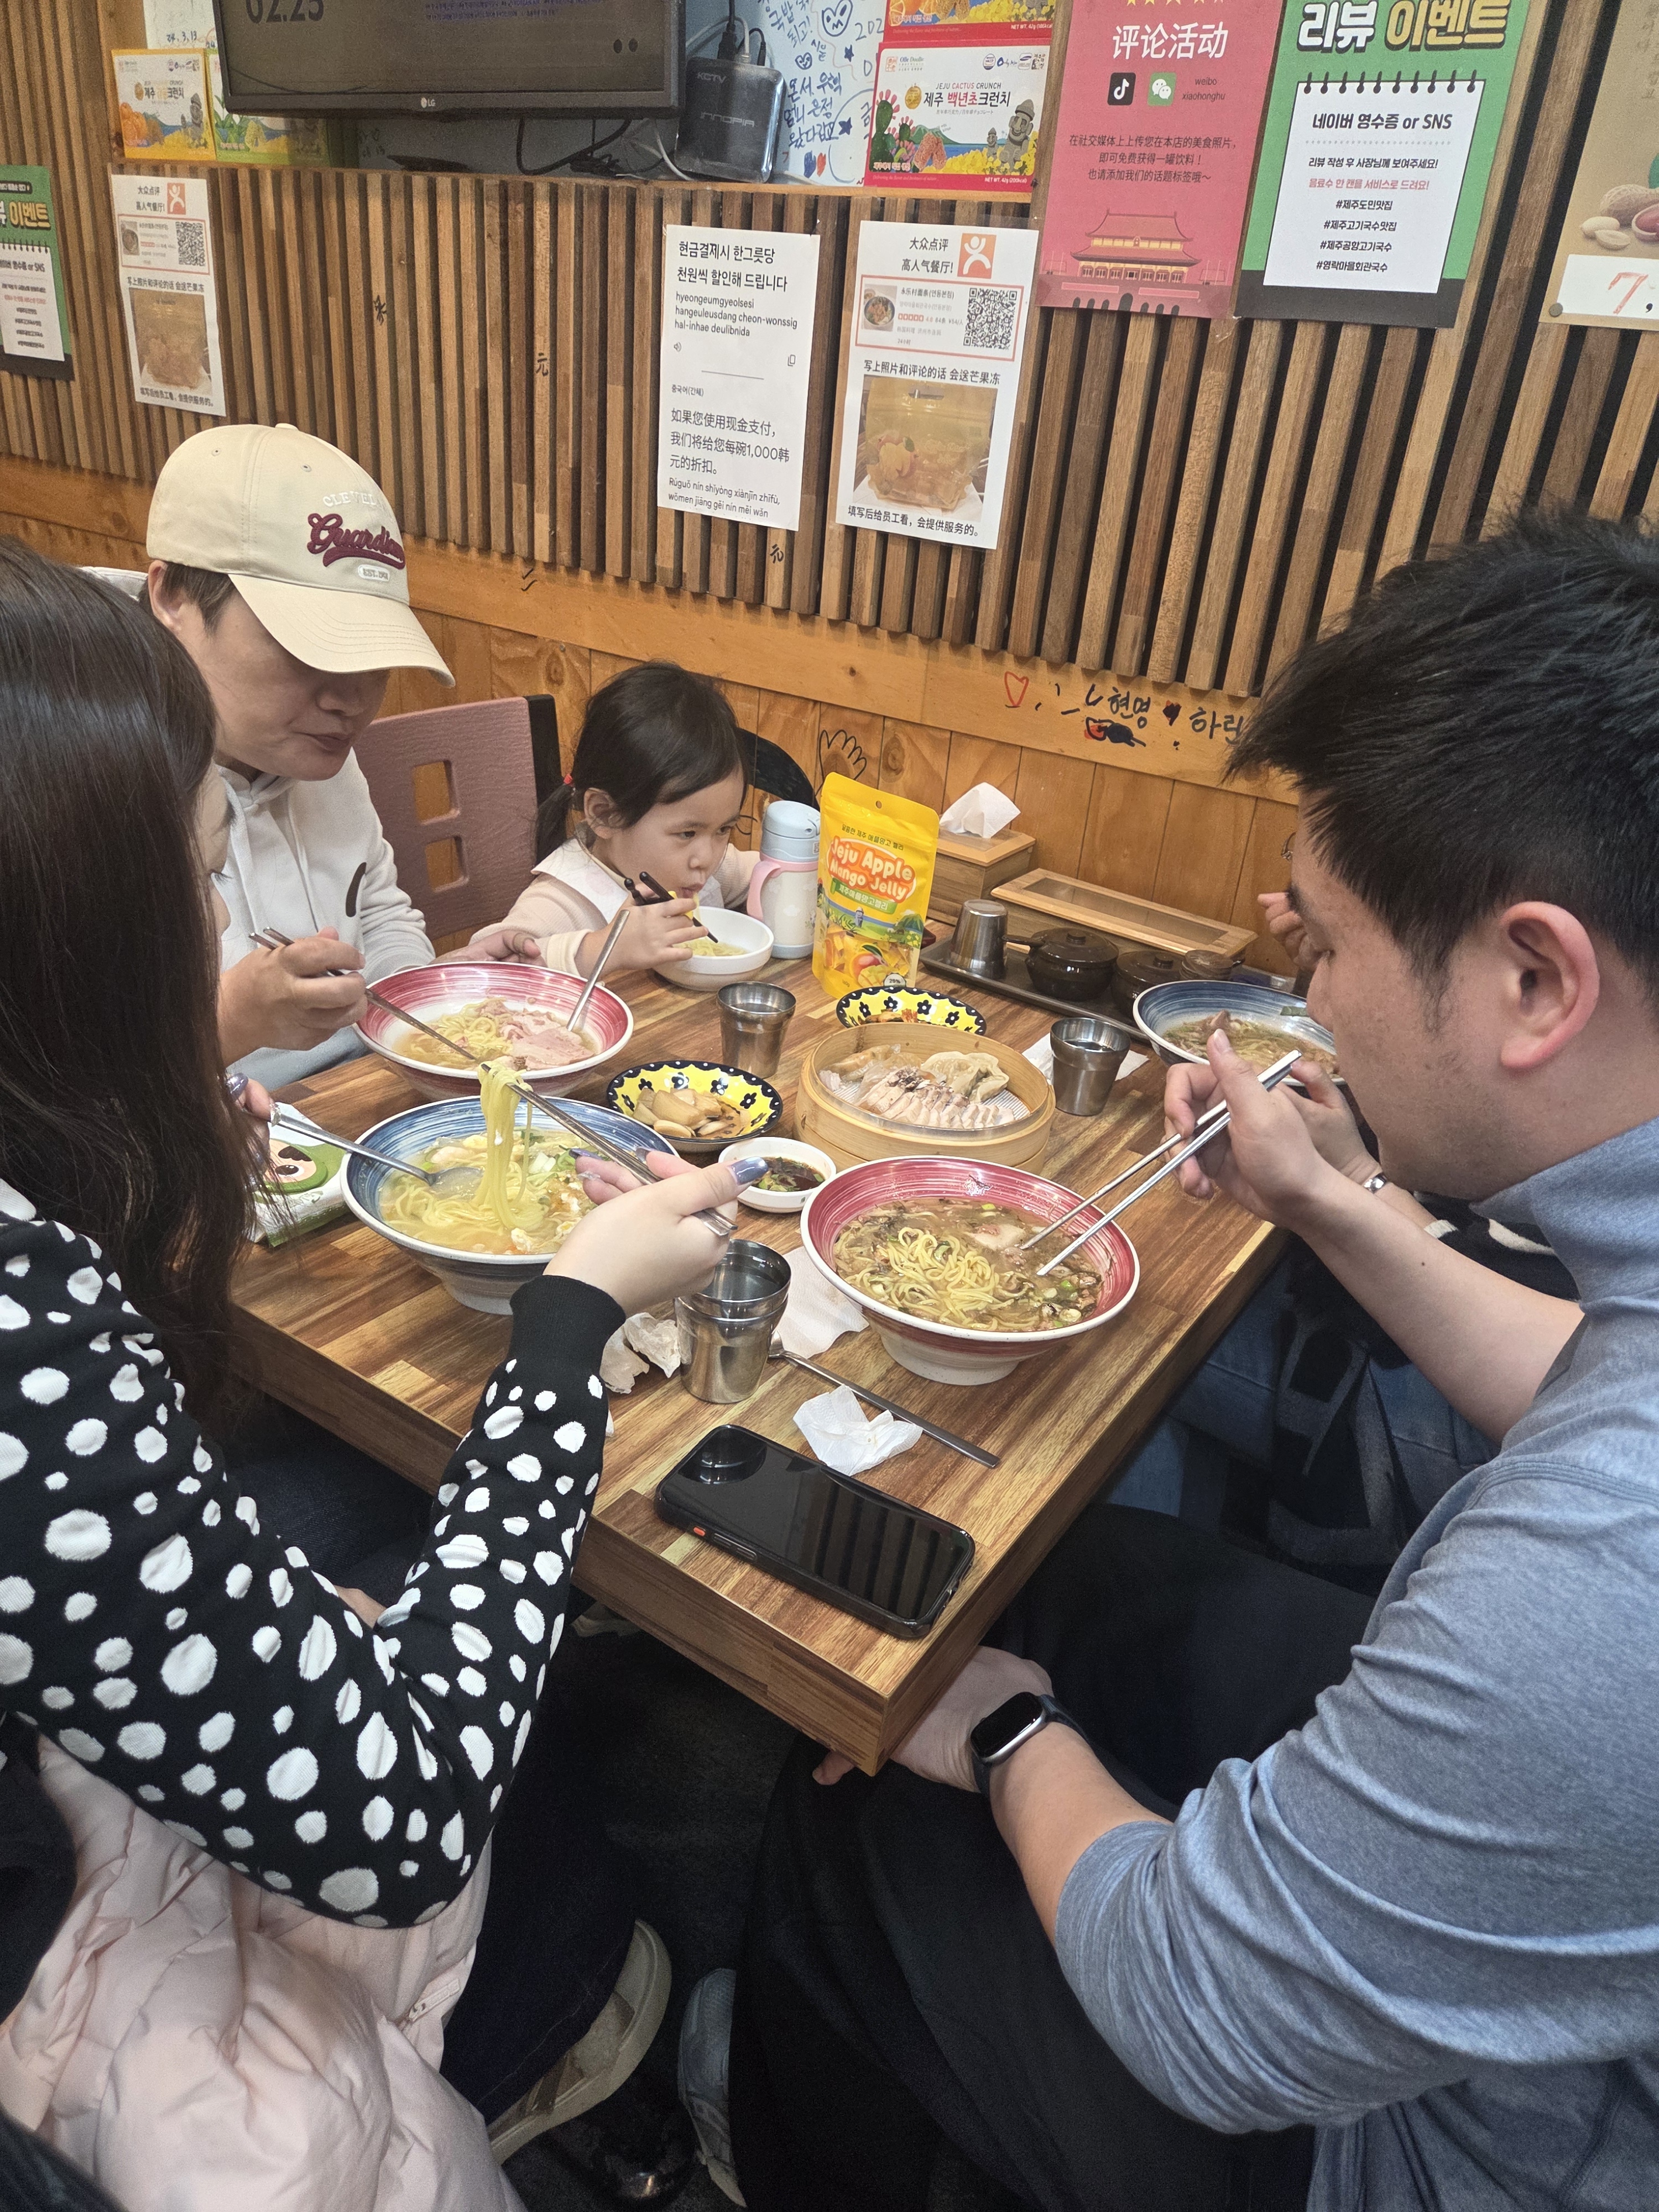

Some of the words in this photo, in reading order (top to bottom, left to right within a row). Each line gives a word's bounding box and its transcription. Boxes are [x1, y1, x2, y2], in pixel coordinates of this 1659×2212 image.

[1297, 1, 1378, 53] 리뷰
[1385, 0, 1511, 51] 이벤트
[1112, 21, 1229, 60] 评论活动
[1194, 77, 1217, 86] weibo
[427, 98, 436, 107] LG
[924, 92, 943, 107] 제주
[947, 91, 1011, 107] 백년초크런치
[1182, 92, 1225, 102] xiaohonghu
[1312, 113, 1354, 129] 네이버
[1357, 113, 1399, 129] 영수증
[1402, 116, 1420, 129] or
[1422, 113, 1453, 129] SNS
[1308, 157, 1326, 167] 리뷰
[1327, 158, 1344, 167] 작성
[1345, 158, 1354, 168] 후
[1355, 158, 1390, 168] 사장님께
[1392, 159, 1438, 169] 보여주세요!
[1309, 179, 1333, 188] 음료수
[1335, 179, 1344, 188] 한
[1345, 179, 1363, 189] 캔을
[1364, 179, 1399, 190] 서비스로
[1400, 180, 1430, 190] 드려요!
[1335, 200, 1393, 210] #제주도민맛집
[9, 201, 51, 228] 이벤트
[1323, 220, 1397, 231] #제주고기국수맛집
[679, 241, 730, 260] 현금결제시
[733, 246, 775, 264] 한그릇당
[909, 237, 948, 252] 大众点评
[1320, 240, 1392, 252] #제주공항고기국수
[901, 258, 953, 274] 高人气餐厅!
[677, 266, 708, 285] 천원씩
[711, 269, 742, 288] 할인해
[744, 273, 788, 292] 드립니다
[676, 291, 754, 309] hyeongeumgyeolsesi
[675, 305, 737, 323] hangeuleusdang
[738, 312, 797, 329] cheon-wonssig
[675, 319, 709, 332] hal-inhae
[711, 323, 750, 336] deulibnida
[864, 360, 947, 380] 写上照片和评论的话
[950, 368, 1001, 385] 会送芒果冻
[671, 408, 775, 437] 如果您使用现金支付，
[671, 431, 790, 462] 我们将给您每碗1,000韩
[670, 455, 717, 474] 元的折扣。
[847, 505, 979, 537] 填写后给员工看，会提供服务的。
[1108, 686, 1151, 729] 현영
[857, 830, 867, 838] 제주
[832, 838, 858, 864] Jeju
[861, 850, 912, 881] Apple
[830, 858, 867, 887] Mango
[870, 877, 907, 901] Jelly
